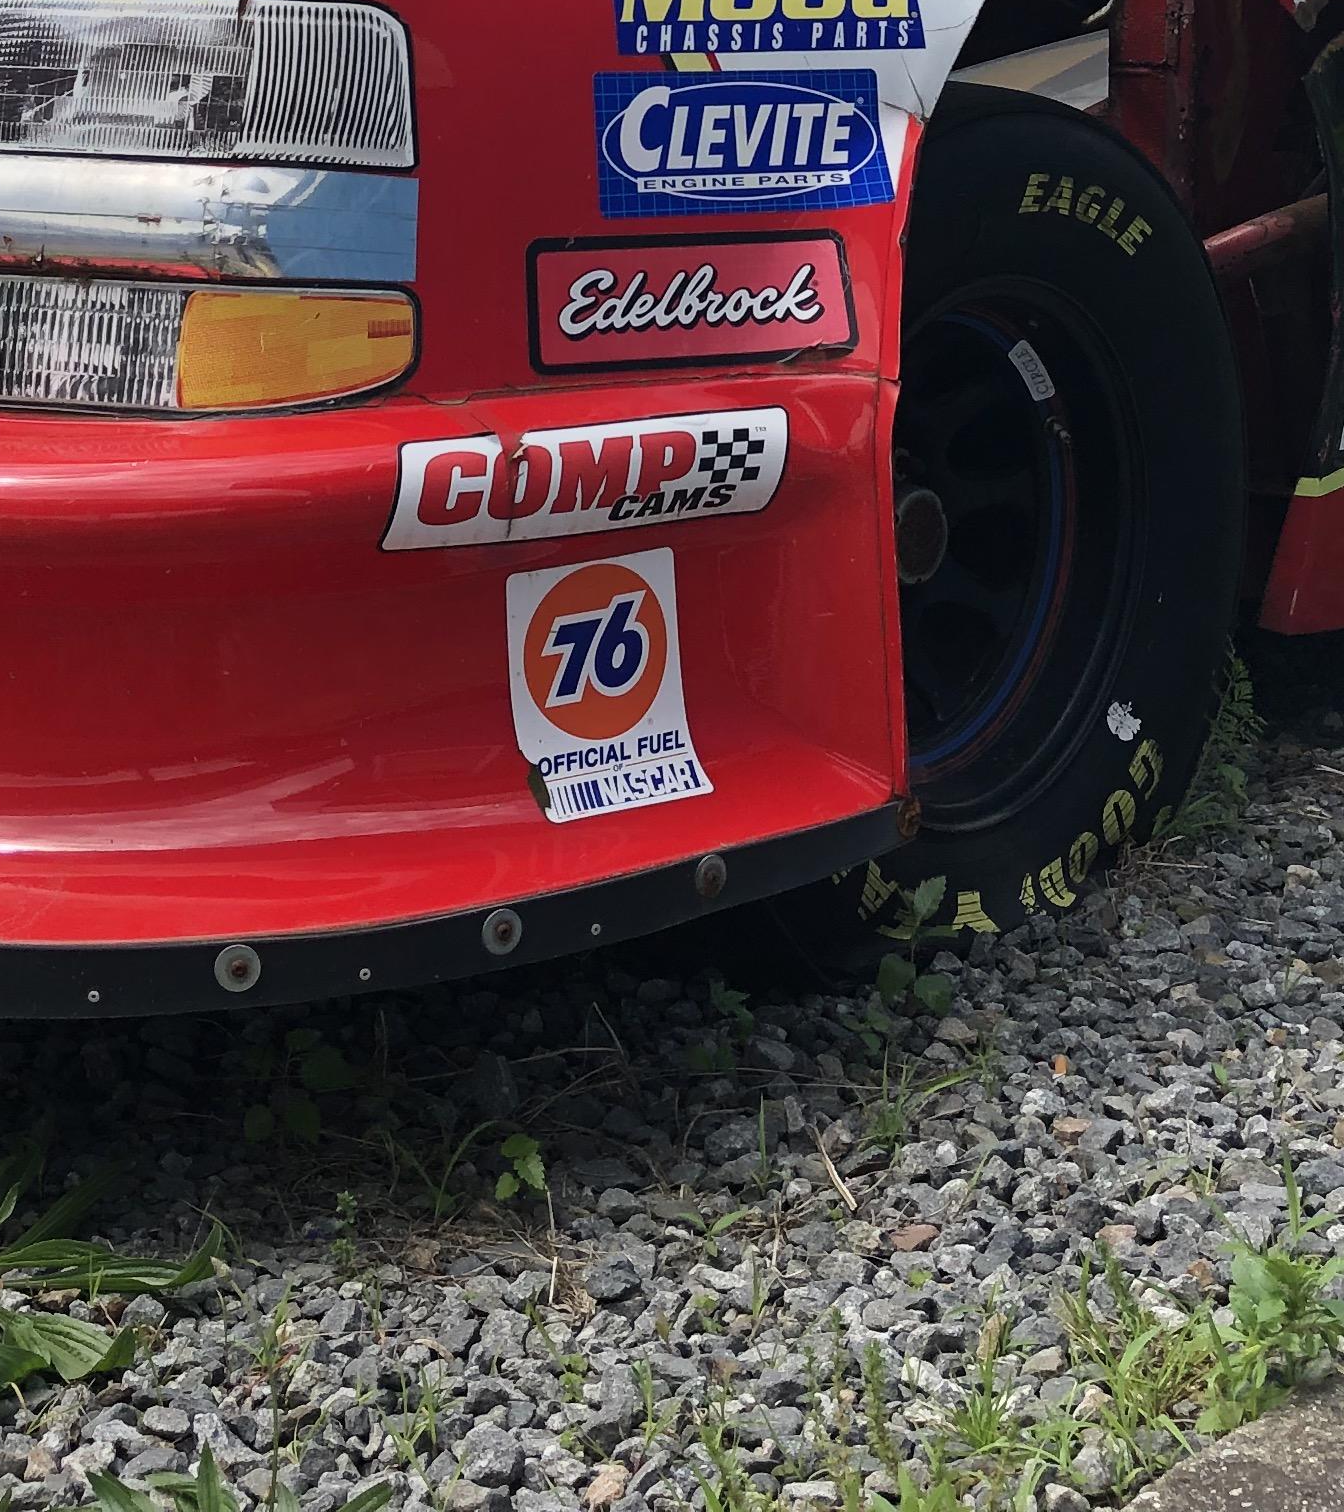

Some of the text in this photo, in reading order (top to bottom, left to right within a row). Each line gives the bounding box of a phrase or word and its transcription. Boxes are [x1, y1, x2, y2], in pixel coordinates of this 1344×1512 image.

[635, 20, 911, 53] CHASSIS PARTS
[619, 85, 856, 170] CLEVITE
[641, 173, 846, 191] ENGINE PARTS
[1018, 172, 1154, 256] EAGLE
[558, 262, 824, 340] Edelbrock
[417, 430, 696, 526] COMP
[607, 483, 738, 523] CAMS
[552, 600, 643, 699] 76
[538, 729, 686, 778] OFFICIAL FUEL
[612, 763, 624, 772] OF
[598, 760, 701, 806] NASCAR
